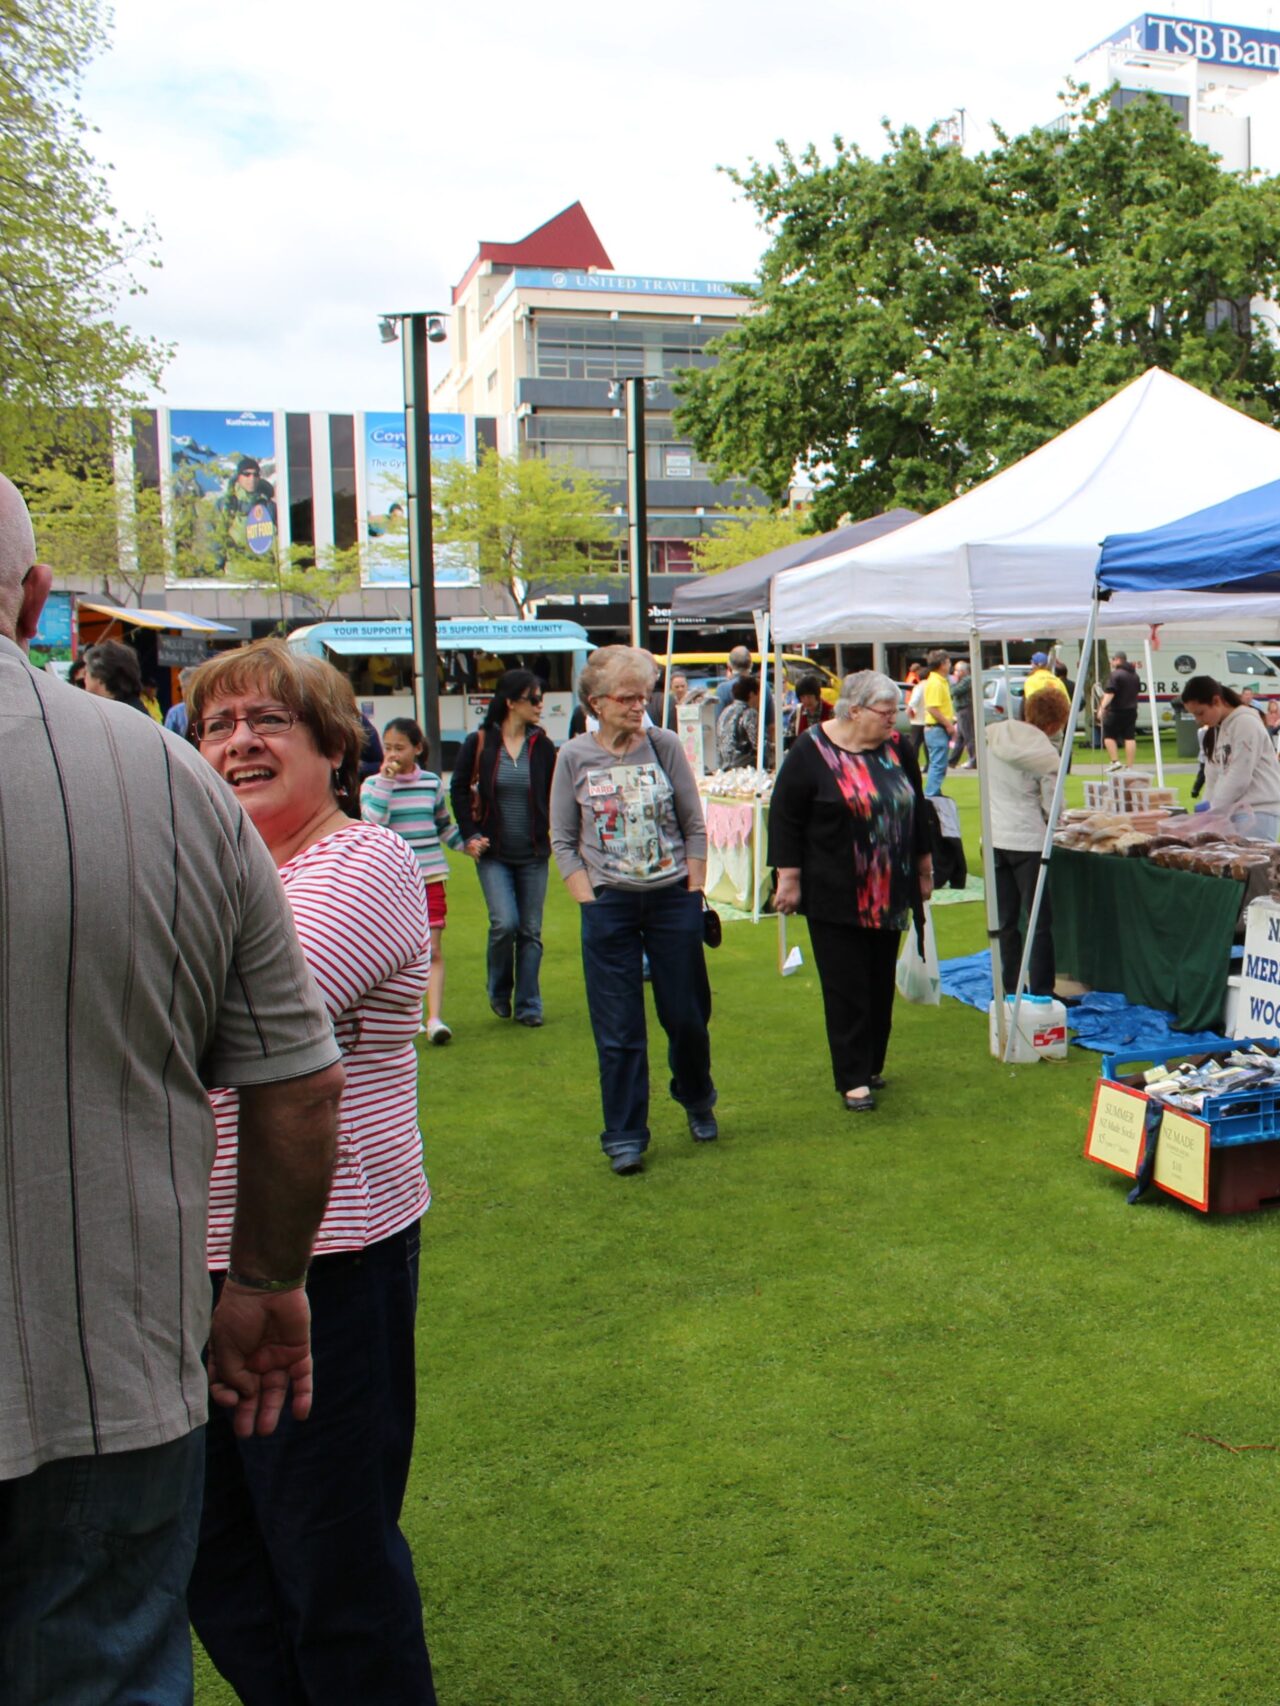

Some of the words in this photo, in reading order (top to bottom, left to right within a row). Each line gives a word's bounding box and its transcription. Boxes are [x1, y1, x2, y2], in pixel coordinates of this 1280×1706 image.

[1148, 17, 1217, 61] TSB
[576, 274, 637, 289] UNITED
[642, 278, 699, 293] TRAVEL
[373, 429, 459, 443] Conure
[334, 627, 359, 636] YOUR
[361, 626, 402, 635] SUPPORT
[449, 625, 489, 634] SUPPORT
[492, 625, 508, 633] THE
[511, 624, 563, 633] COMMUNITY
[1105, 1103, 1135, 1124] SUMMER
[1173, 1131, 1194, 1151] MADE
